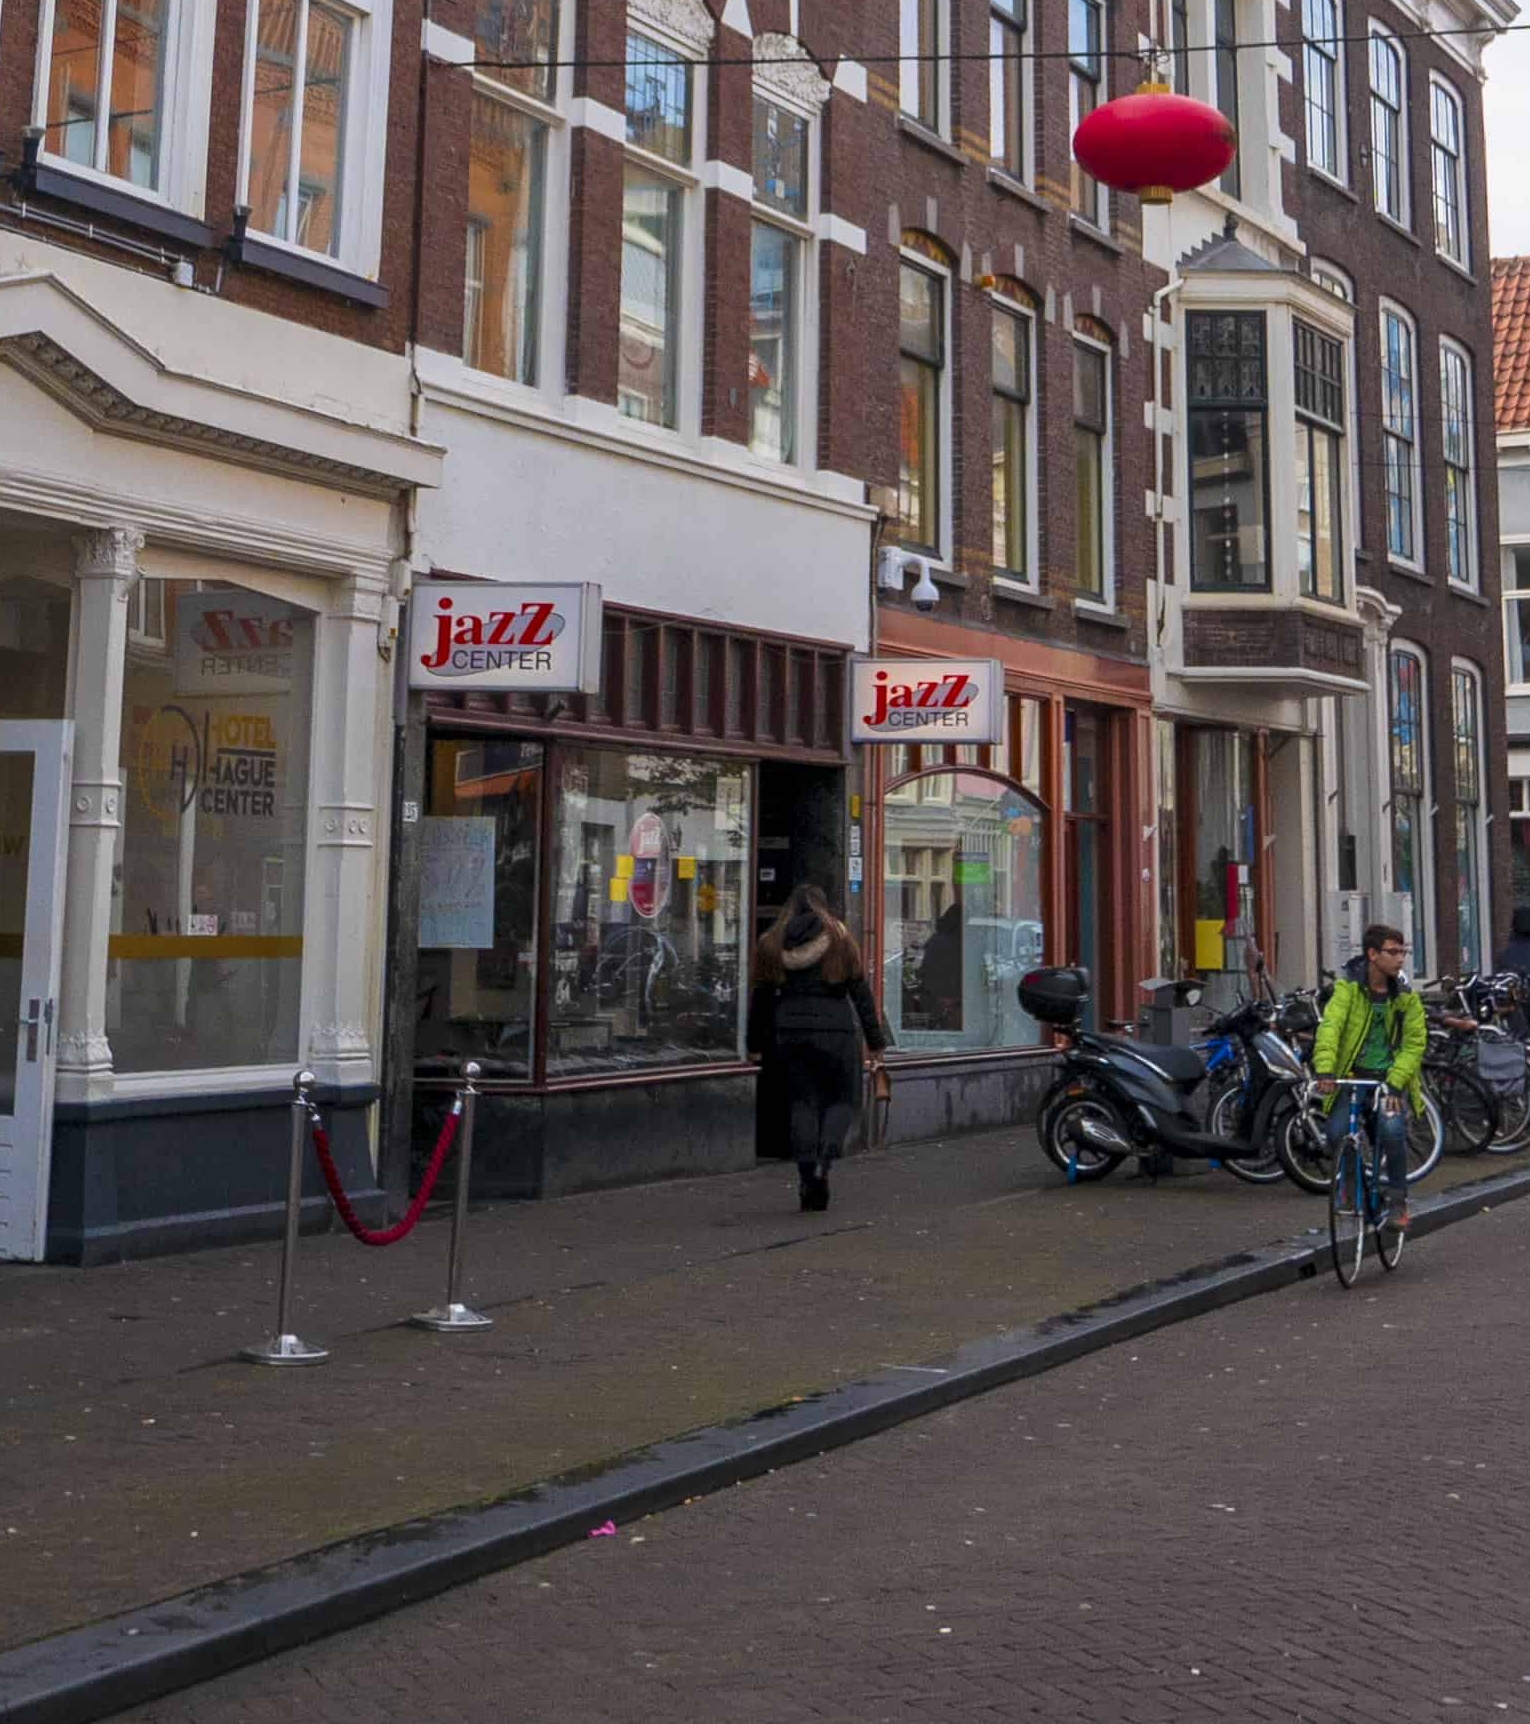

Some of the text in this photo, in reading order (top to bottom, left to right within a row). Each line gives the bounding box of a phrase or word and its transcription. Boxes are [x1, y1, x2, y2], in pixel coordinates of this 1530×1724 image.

[452, 649, 552, 670] CENTER
[888, 711, 969, 726] CENTER
[203, 753, 277, 788] HAGUE
[199, 786, 274, 818] CENTER
